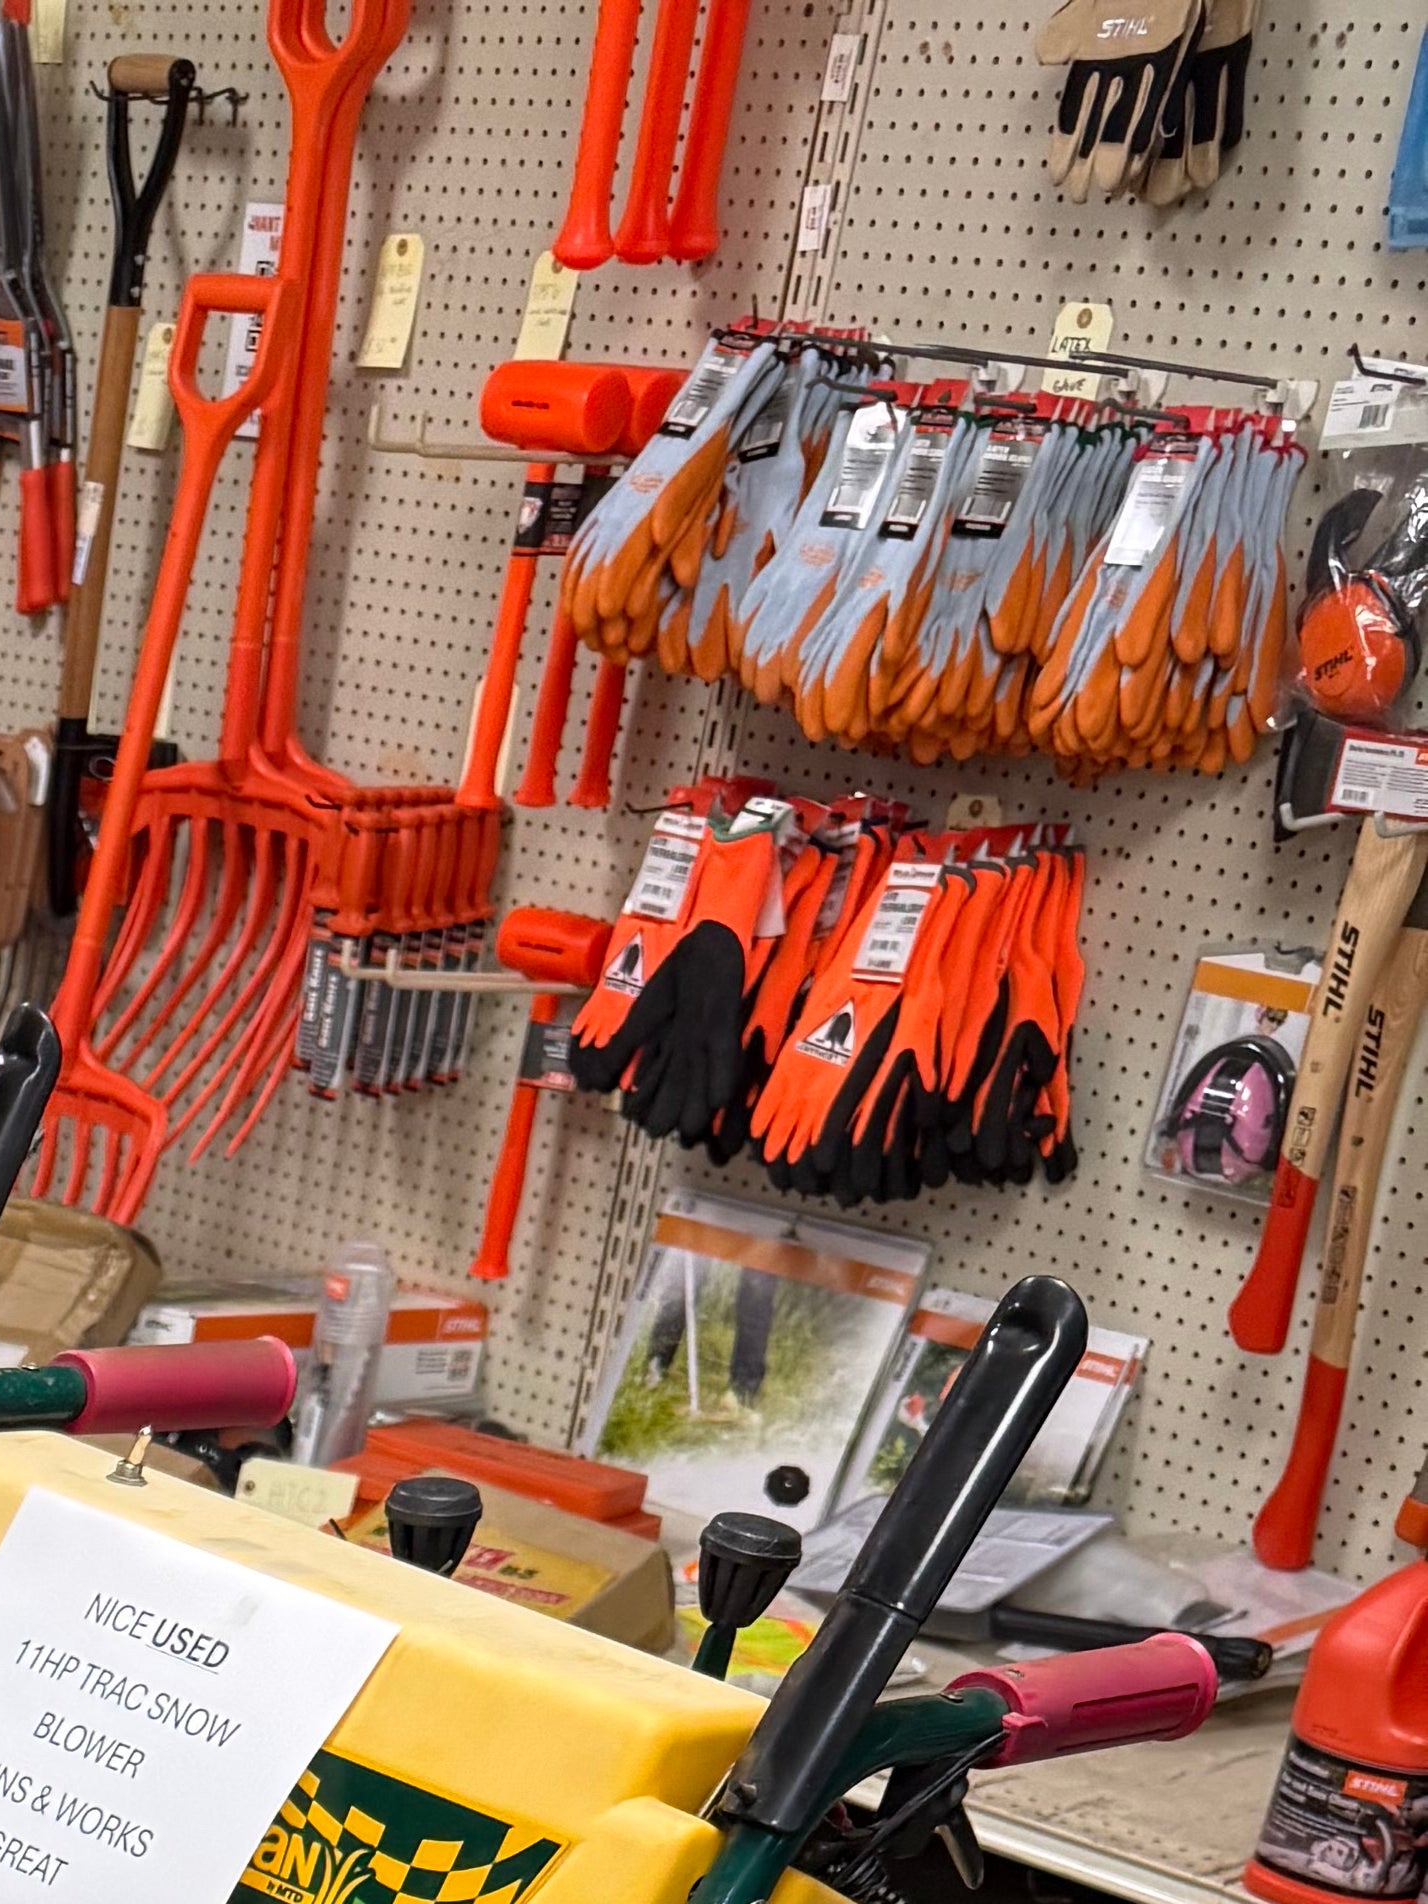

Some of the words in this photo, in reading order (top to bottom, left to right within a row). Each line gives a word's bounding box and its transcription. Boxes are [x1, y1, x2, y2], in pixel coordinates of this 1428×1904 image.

[1097, 17, 1148, 39] STIHL
[1315, 650, 1353, 681] STIHL
[1323, 920, 1361, 1018] STIHL
[1354, 1003, 1386, 1099] STIHL
[84, 1593, 155, 1640] NICE
[151, 1618, 230, 1669] USED
[15, 1639, 81, 1681] 11HP
[79, 1663, 149, 1711] TRAC
[147, 1692, 242, 1747] SNOW
[33, 1712, 146, 1779] BLOWER
[31, 1785, 52, 1815] &
[56, 1792, 154, 1858] WORKS
[277, 1884, 304, 1904] MTD
